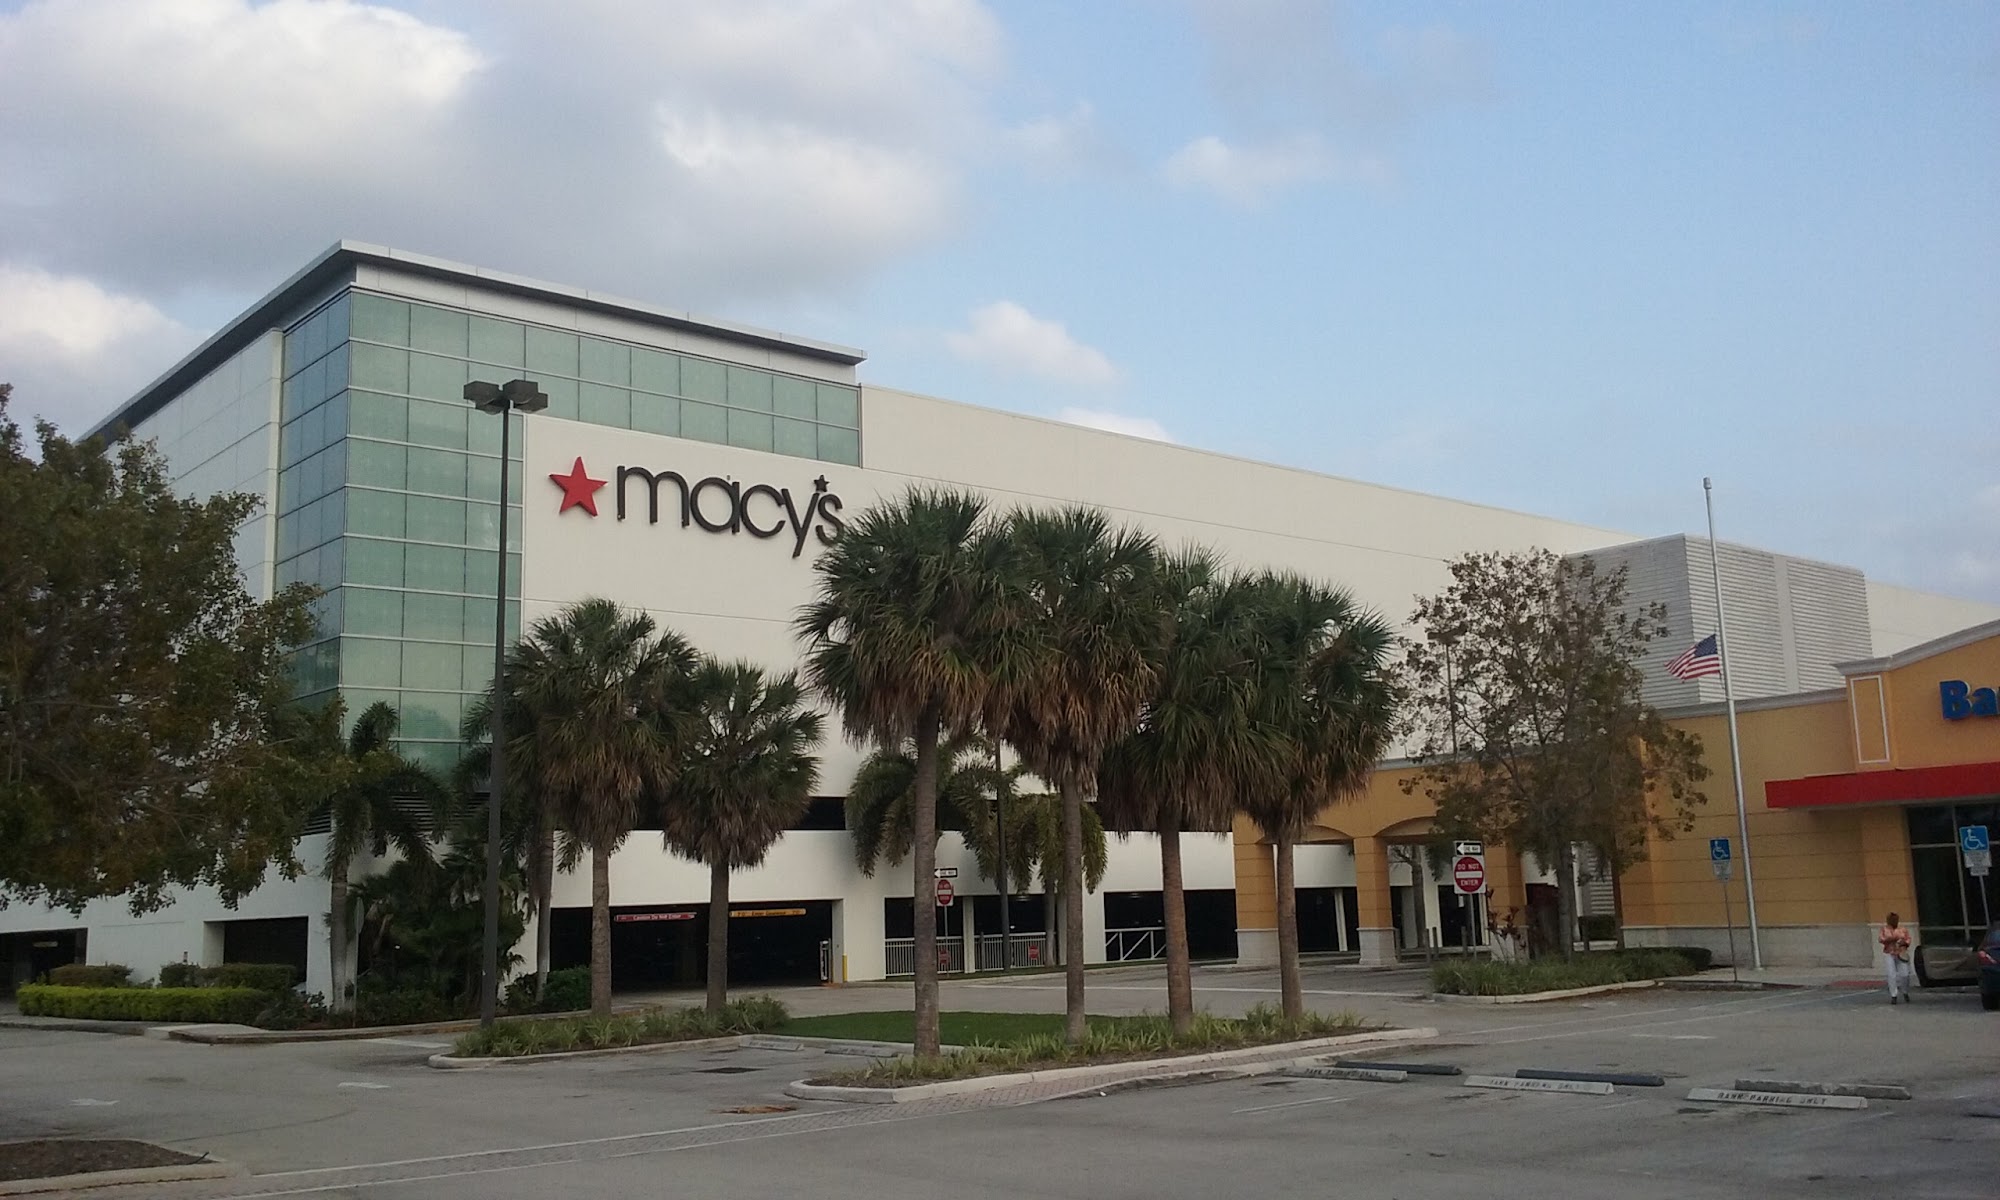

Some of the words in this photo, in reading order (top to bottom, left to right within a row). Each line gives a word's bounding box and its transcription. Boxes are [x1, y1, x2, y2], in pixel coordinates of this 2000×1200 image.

[616, 465, 844, 559] macy's
[1938, 679, 2000, 720] Ba
[1749, 1094, 1792, 1104] PARKING
